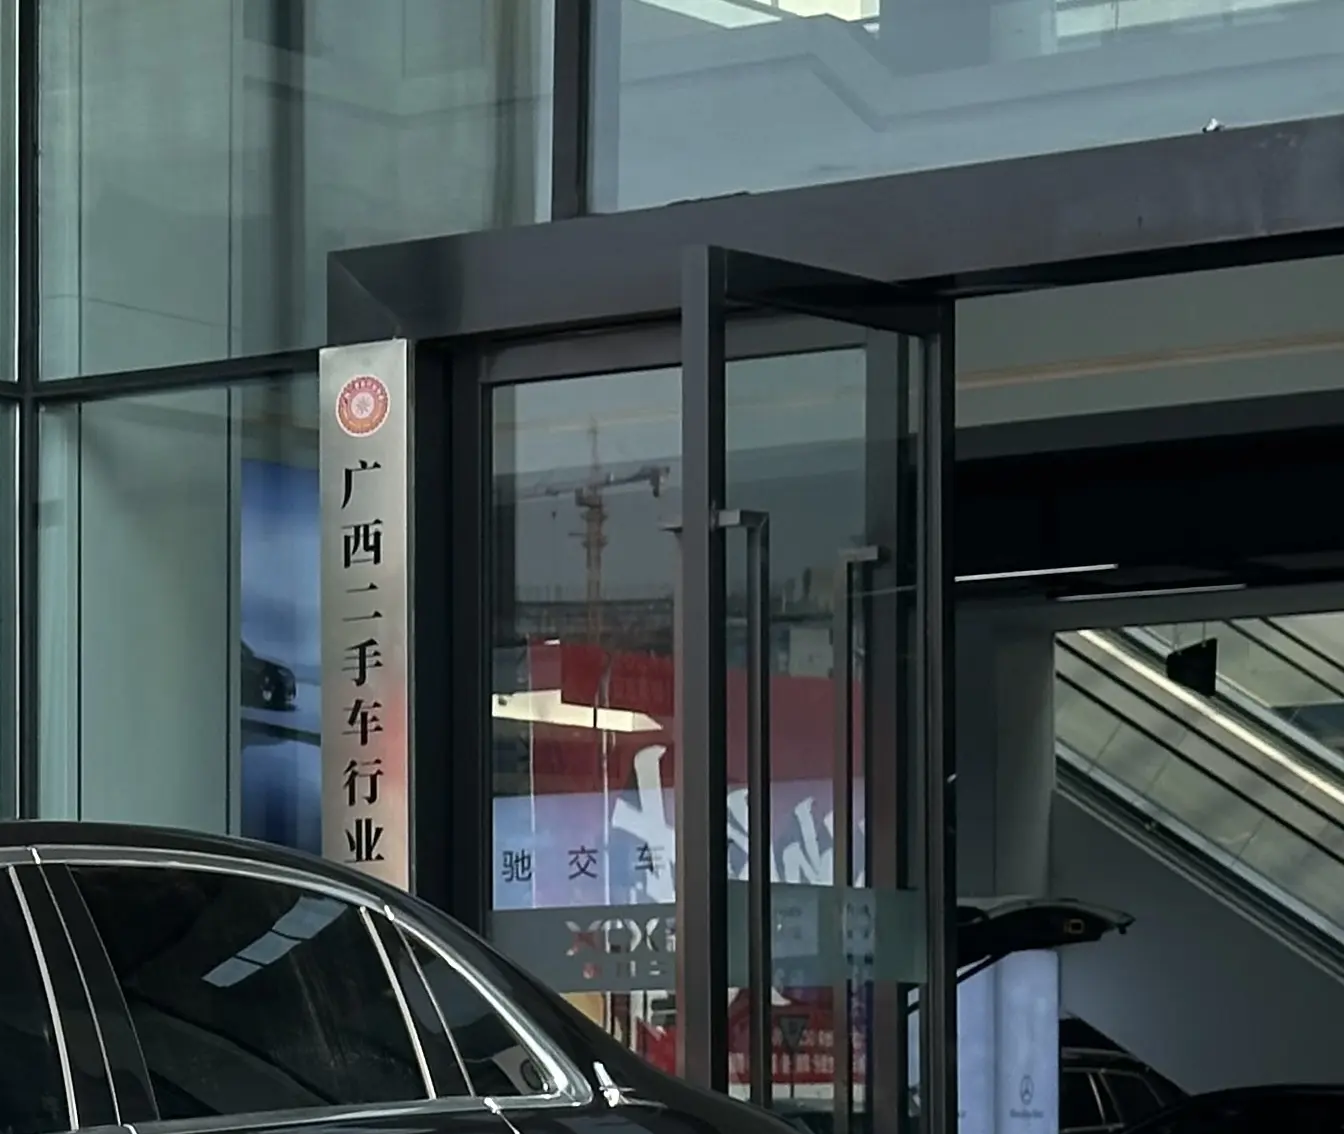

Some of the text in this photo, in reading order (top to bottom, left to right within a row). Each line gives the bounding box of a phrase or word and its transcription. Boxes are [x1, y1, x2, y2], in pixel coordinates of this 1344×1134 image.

[341, 458, 385, 865] 广西二手车行业
